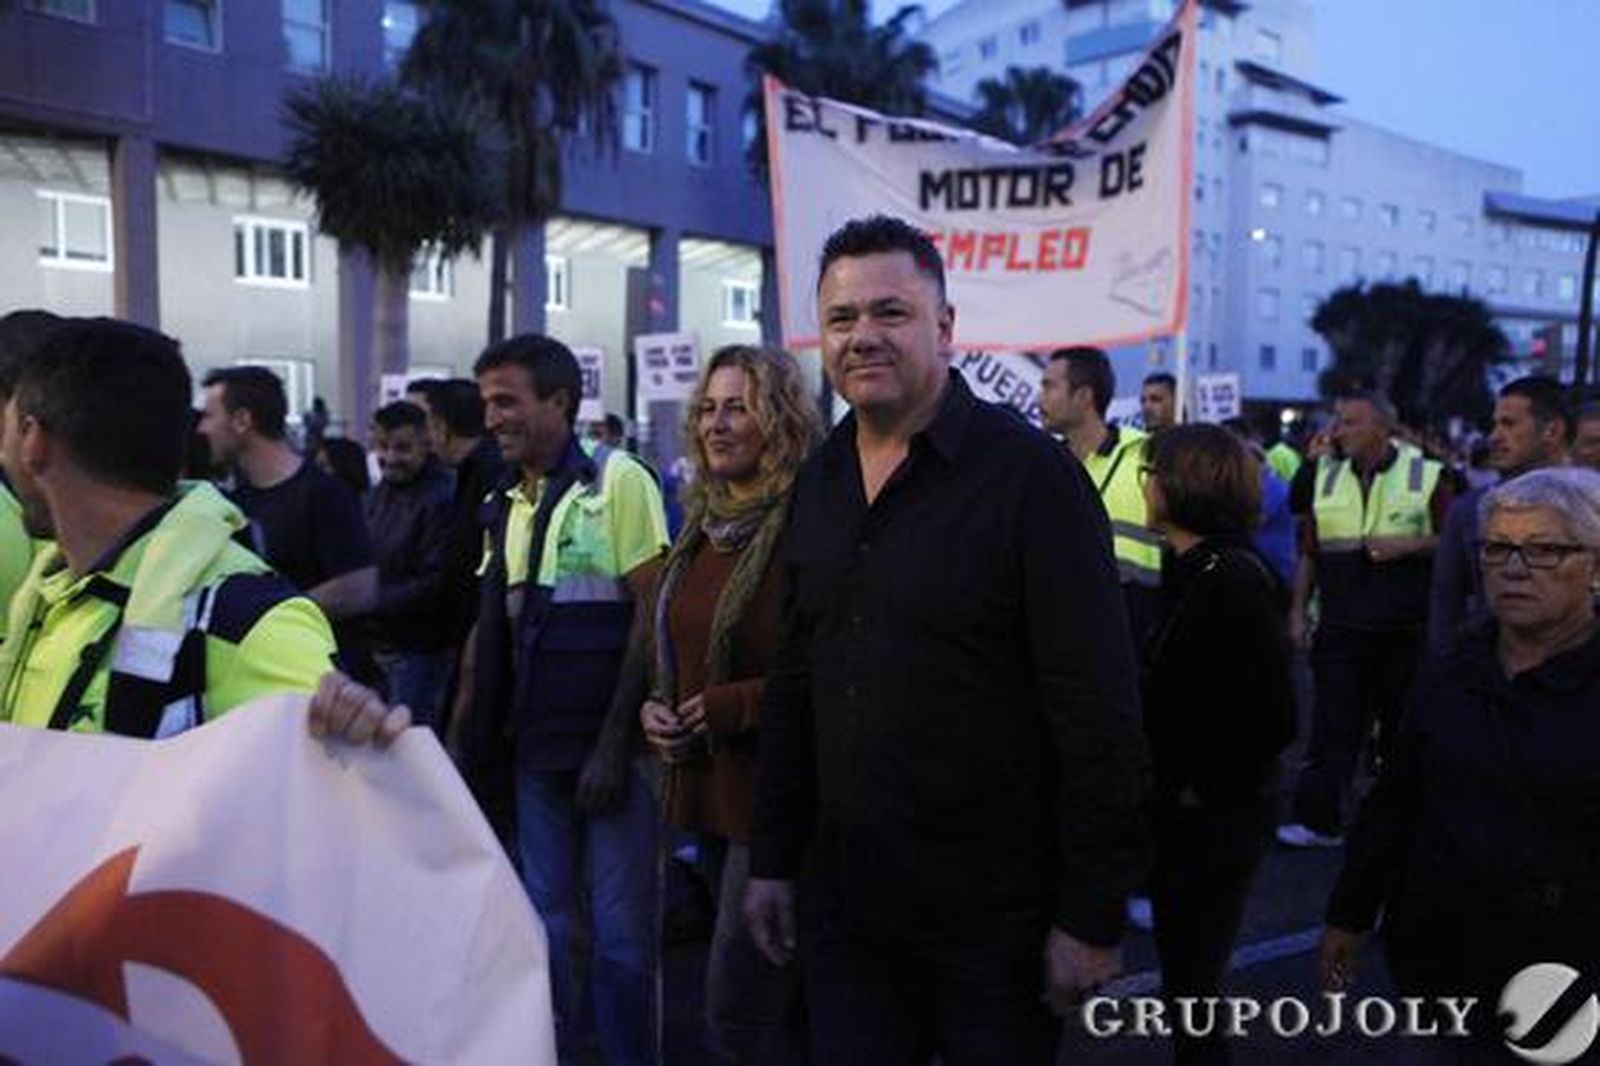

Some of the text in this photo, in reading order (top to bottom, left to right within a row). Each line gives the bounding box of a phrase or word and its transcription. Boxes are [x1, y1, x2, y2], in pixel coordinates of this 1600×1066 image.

[784, 94, 838, 139] EL
[919, 142, 1148, 211] MOTOR DE
